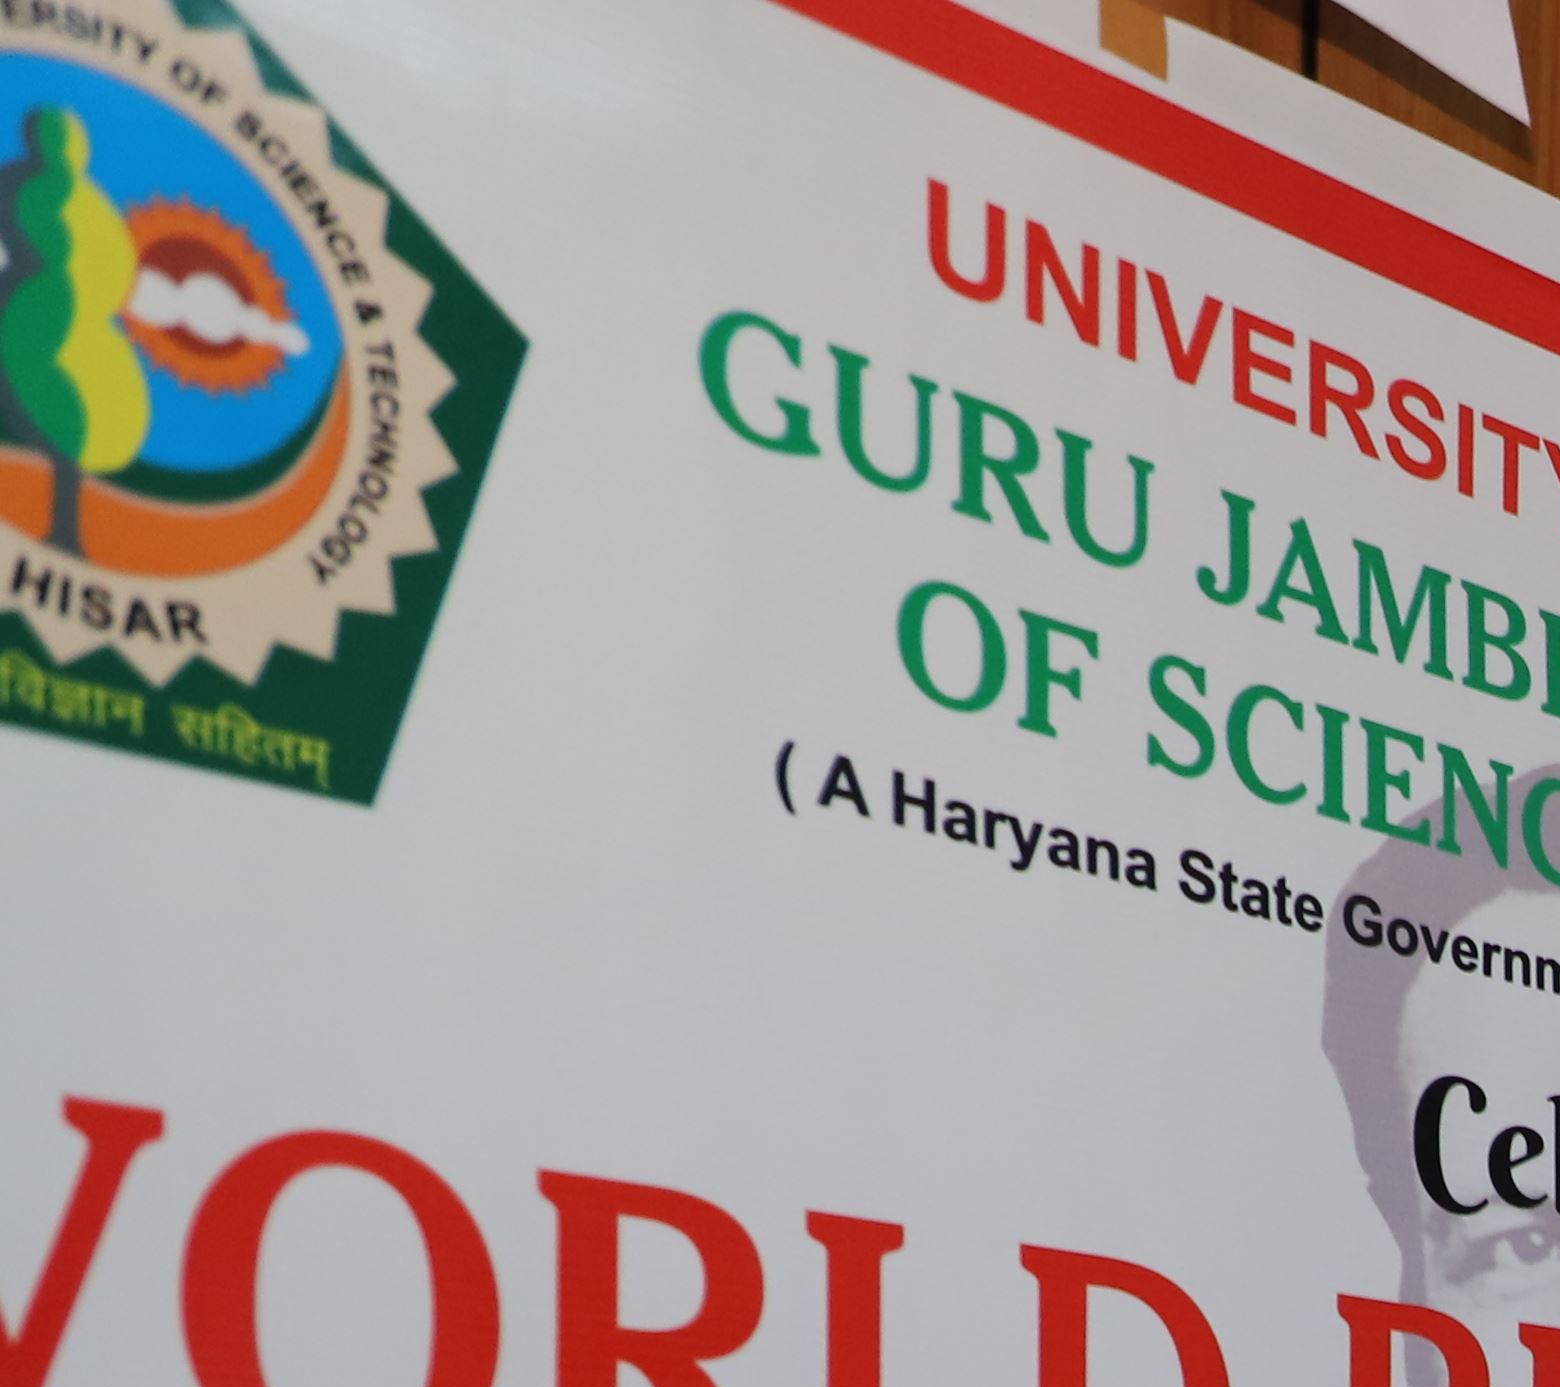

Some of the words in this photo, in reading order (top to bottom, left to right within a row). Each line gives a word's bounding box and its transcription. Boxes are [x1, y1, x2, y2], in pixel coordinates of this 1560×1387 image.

[170, 57, 227, 104] OF
[234, 110, 370, 286] SCIENCE
[307, 338, 399, 588] TECHNOLOGY
[697, 309, 1155, 568] GURU
[9, 555, 207, 646] HISAR
[896, 579, 1100, 738] OF
[893, 770, 1158, 892] Haryana
[1178, 849, 1325, 934] State
